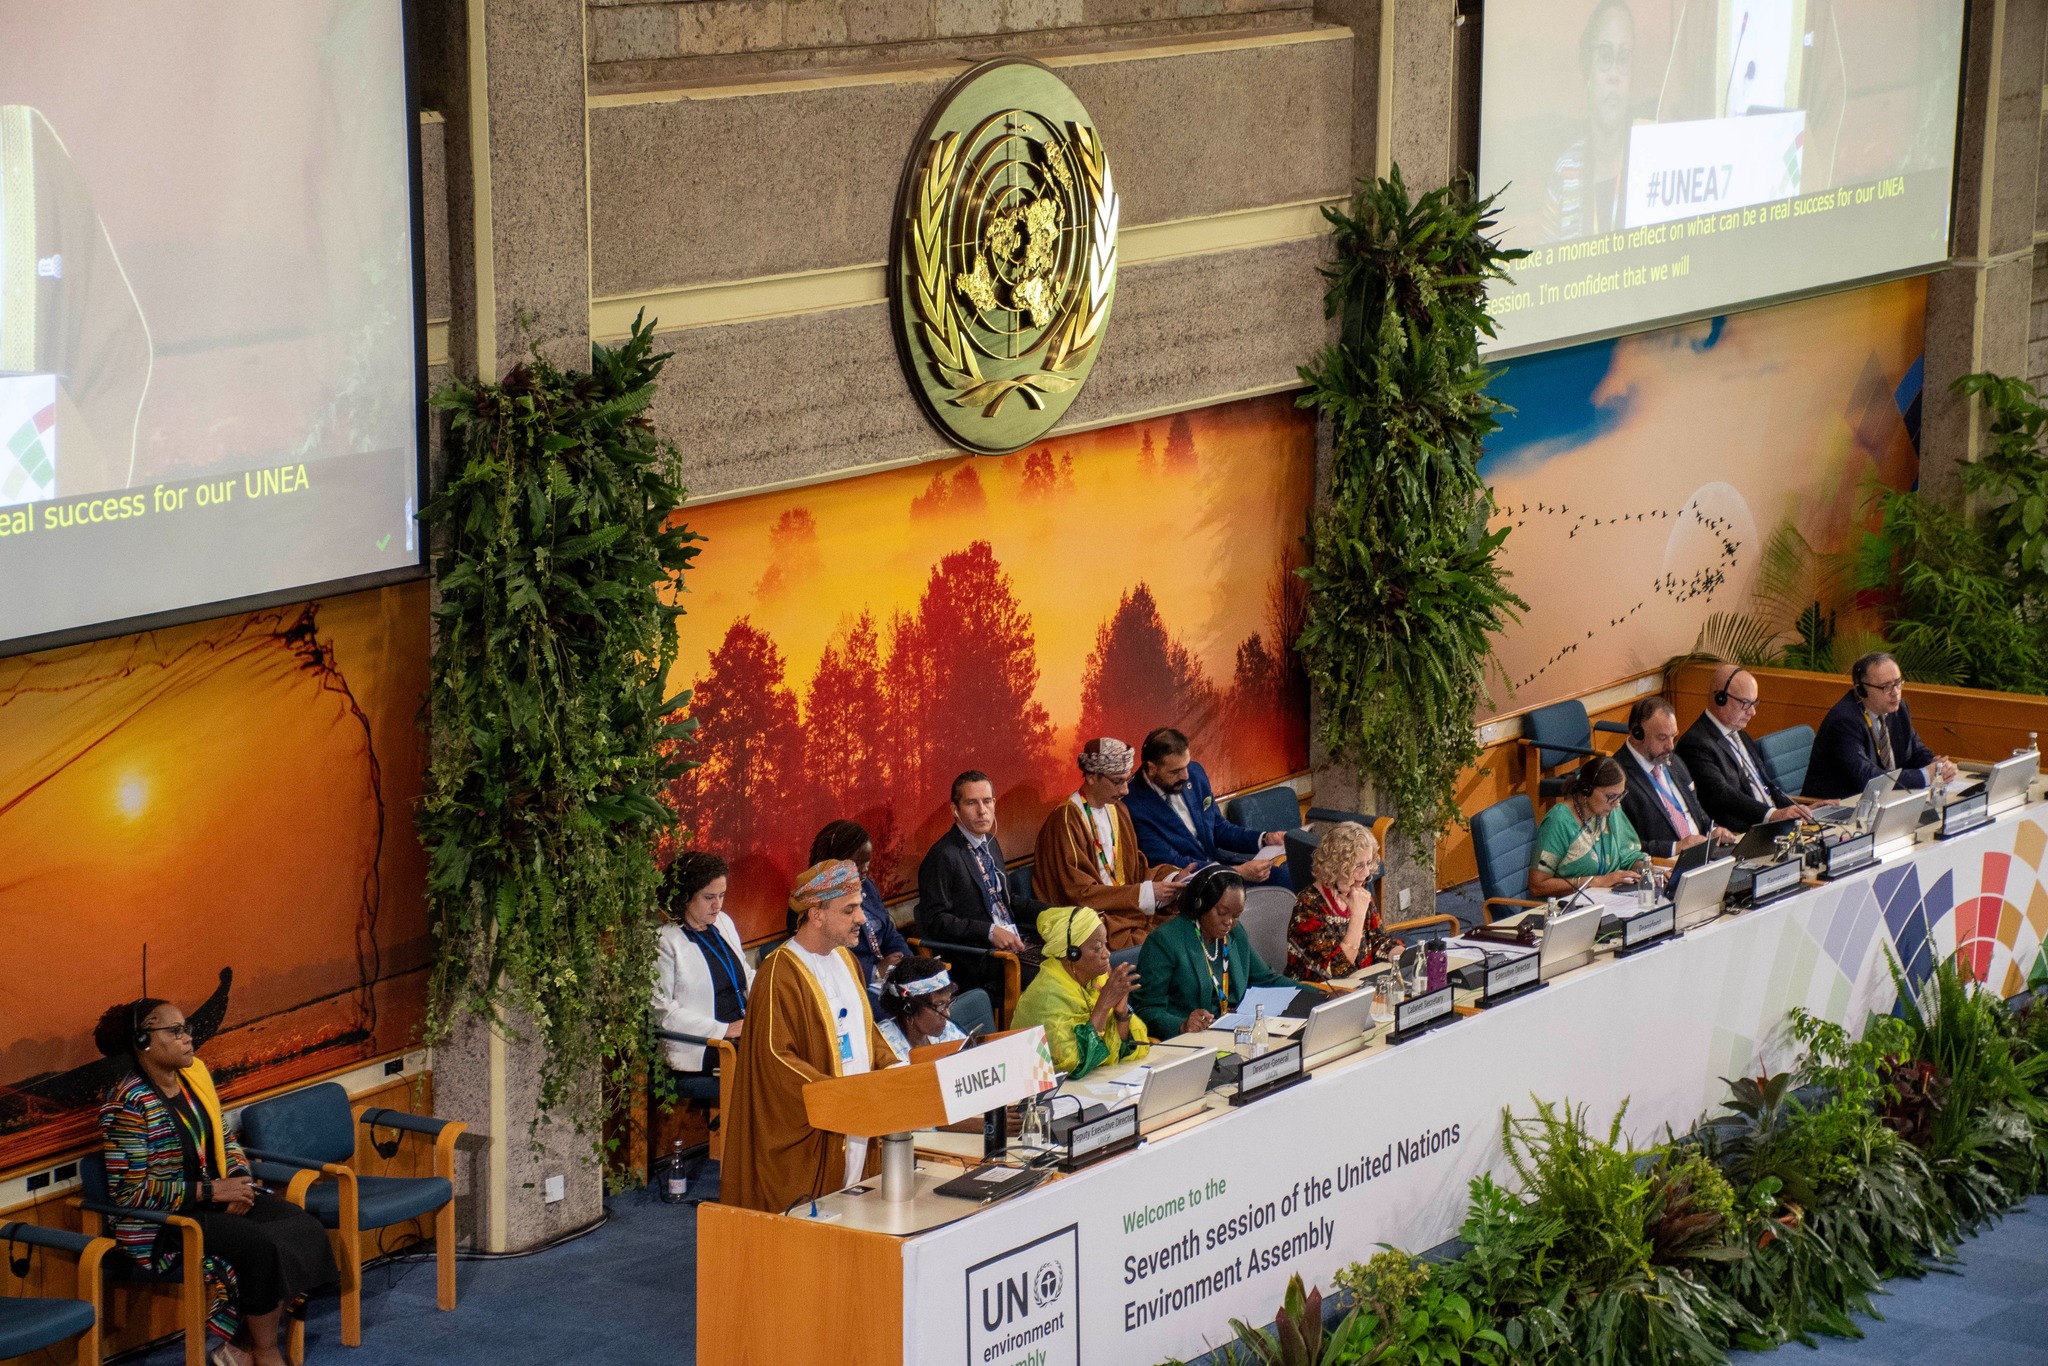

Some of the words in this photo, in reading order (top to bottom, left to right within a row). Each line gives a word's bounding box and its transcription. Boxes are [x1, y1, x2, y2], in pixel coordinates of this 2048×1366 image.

[1646, 164, 1733, 208] #UNEA7
[1546, 248, 1553, 265] a
[1558, 235, 1609, 262] moment
[1613, 232, 1625, 252] to
[1628, 222, 1666, 249] reflect
[1670, 221, 1684, 242] on
[1687, 213, 1716, 237] what
[1719, 209, 1739, 232] can
[1743, 204, 1757, 227] be
[1760, 206, 1767, 224] a
[1770, 196, 1791, 221] real
[1793, 191, 1835, 218] success
[1837, 184, 1853, 208] for
[1855, 183, 1875, 205] our
[1878, 175, 1905, 200] UNEA
[1484, 290, 1535, 316] session.
[1540, 283, 1559, 305] I'm
[1564, 273, 1620, 301] confident
[1623, 265, 1647, 288] that
[1650, 263, 1669, 283] we
[1672, 254, 1691, 277] will
[0, 503, 34, 537] eal
[44, 493, 145, 529] success
[153, 484, 188, 512] for
[196, 479, 236, 506] our
[245, 463, 310, 498] UNEA
[954, 1063, 1006, 1098] #UNEA7
[1252, 1053, 1290, 1075] Director-General
[1072, 1128, 1091, 1144] Deputy
[1091, 1119, 1115, 1137] Executive
[1115, 1113, 1135, 1127] Director
[1122, 1196, 1185, 1235] Welcome
[1188, 1189, 1201, 1208] to
[1205, 1178, 1226, 1201] the
[1123, 1229, 1200, 1285] Seventh
[1206, 1203, 1275, 1250] session
[1281, 1182, 1300, 1217] of
[1304, 1176, 1331, 1207] the
[1337, 1144, 1392, 1192] United
[1397, 1123, 1460, 1168] Nations
[983, 1271, 1028, 1332] UN
[1124, 1257, 1242, 1332] Environment
[1247, 1216, 1334, 1279] Assembly
[984, 1312, 1064, 1363] environment
